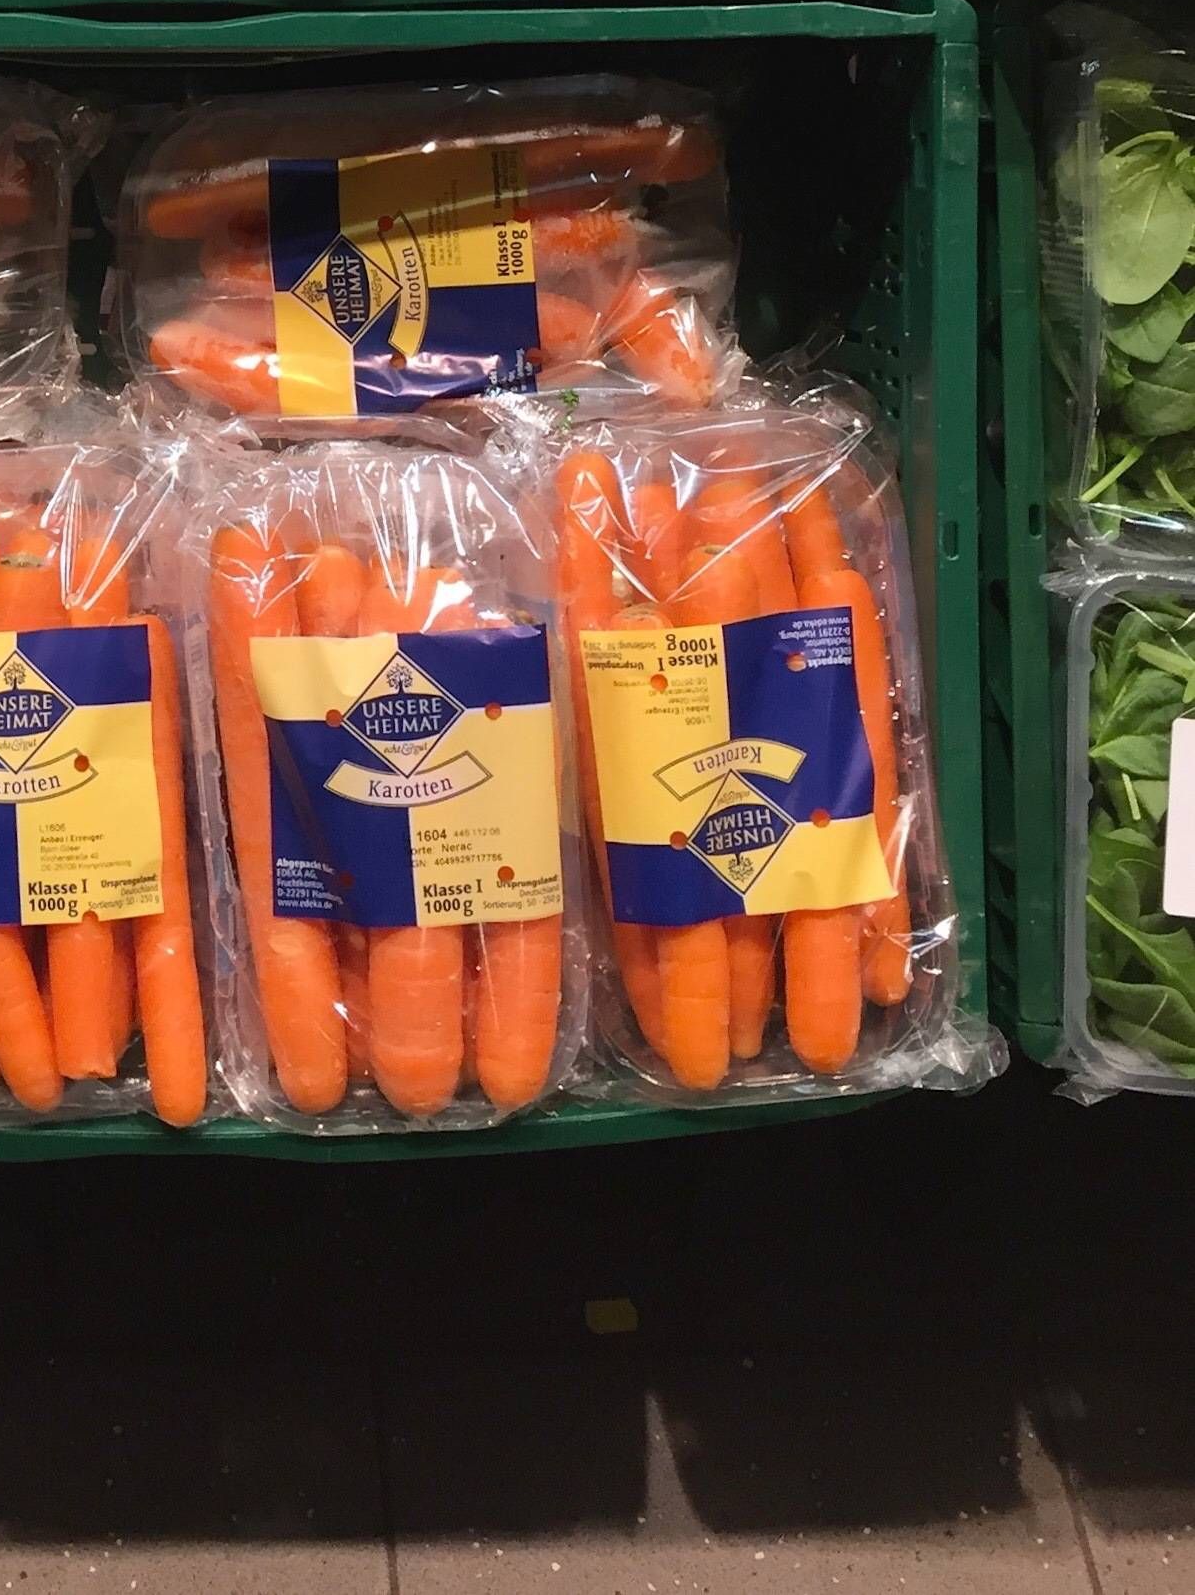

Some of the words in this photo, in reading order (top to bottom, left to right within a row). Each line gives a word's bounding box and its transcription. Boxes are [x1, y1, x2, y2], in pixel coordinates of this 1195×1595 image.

[496, 231, 510, 278] Klasse
[330, 254, 349, 325] UNSERE
[347, 255, 365, 323] HEIMAT
[402, 246, 421, 322] Karotten
[669, 653, 718, 668] Klasse
[363, 698, 443, 719] UNSERE
[365, 715, 442, 736] HEIMAT
[693, 745, 761, 773] Karotten
[368, 777, 453, 799] Karotten
[706, 808, 771, 836] HEIMAT
[416, 828, 447, 842] 1604
[706, 826, 775, 854] UNSERE
[441, 842, 473, 853] Nerac
[276, 858, 322, 870] Abgepackt
[28, 881, 77, 895] Klasse
[277, 887, 309, 897] D-22291
[423, 883, 472, 898] Klasse
